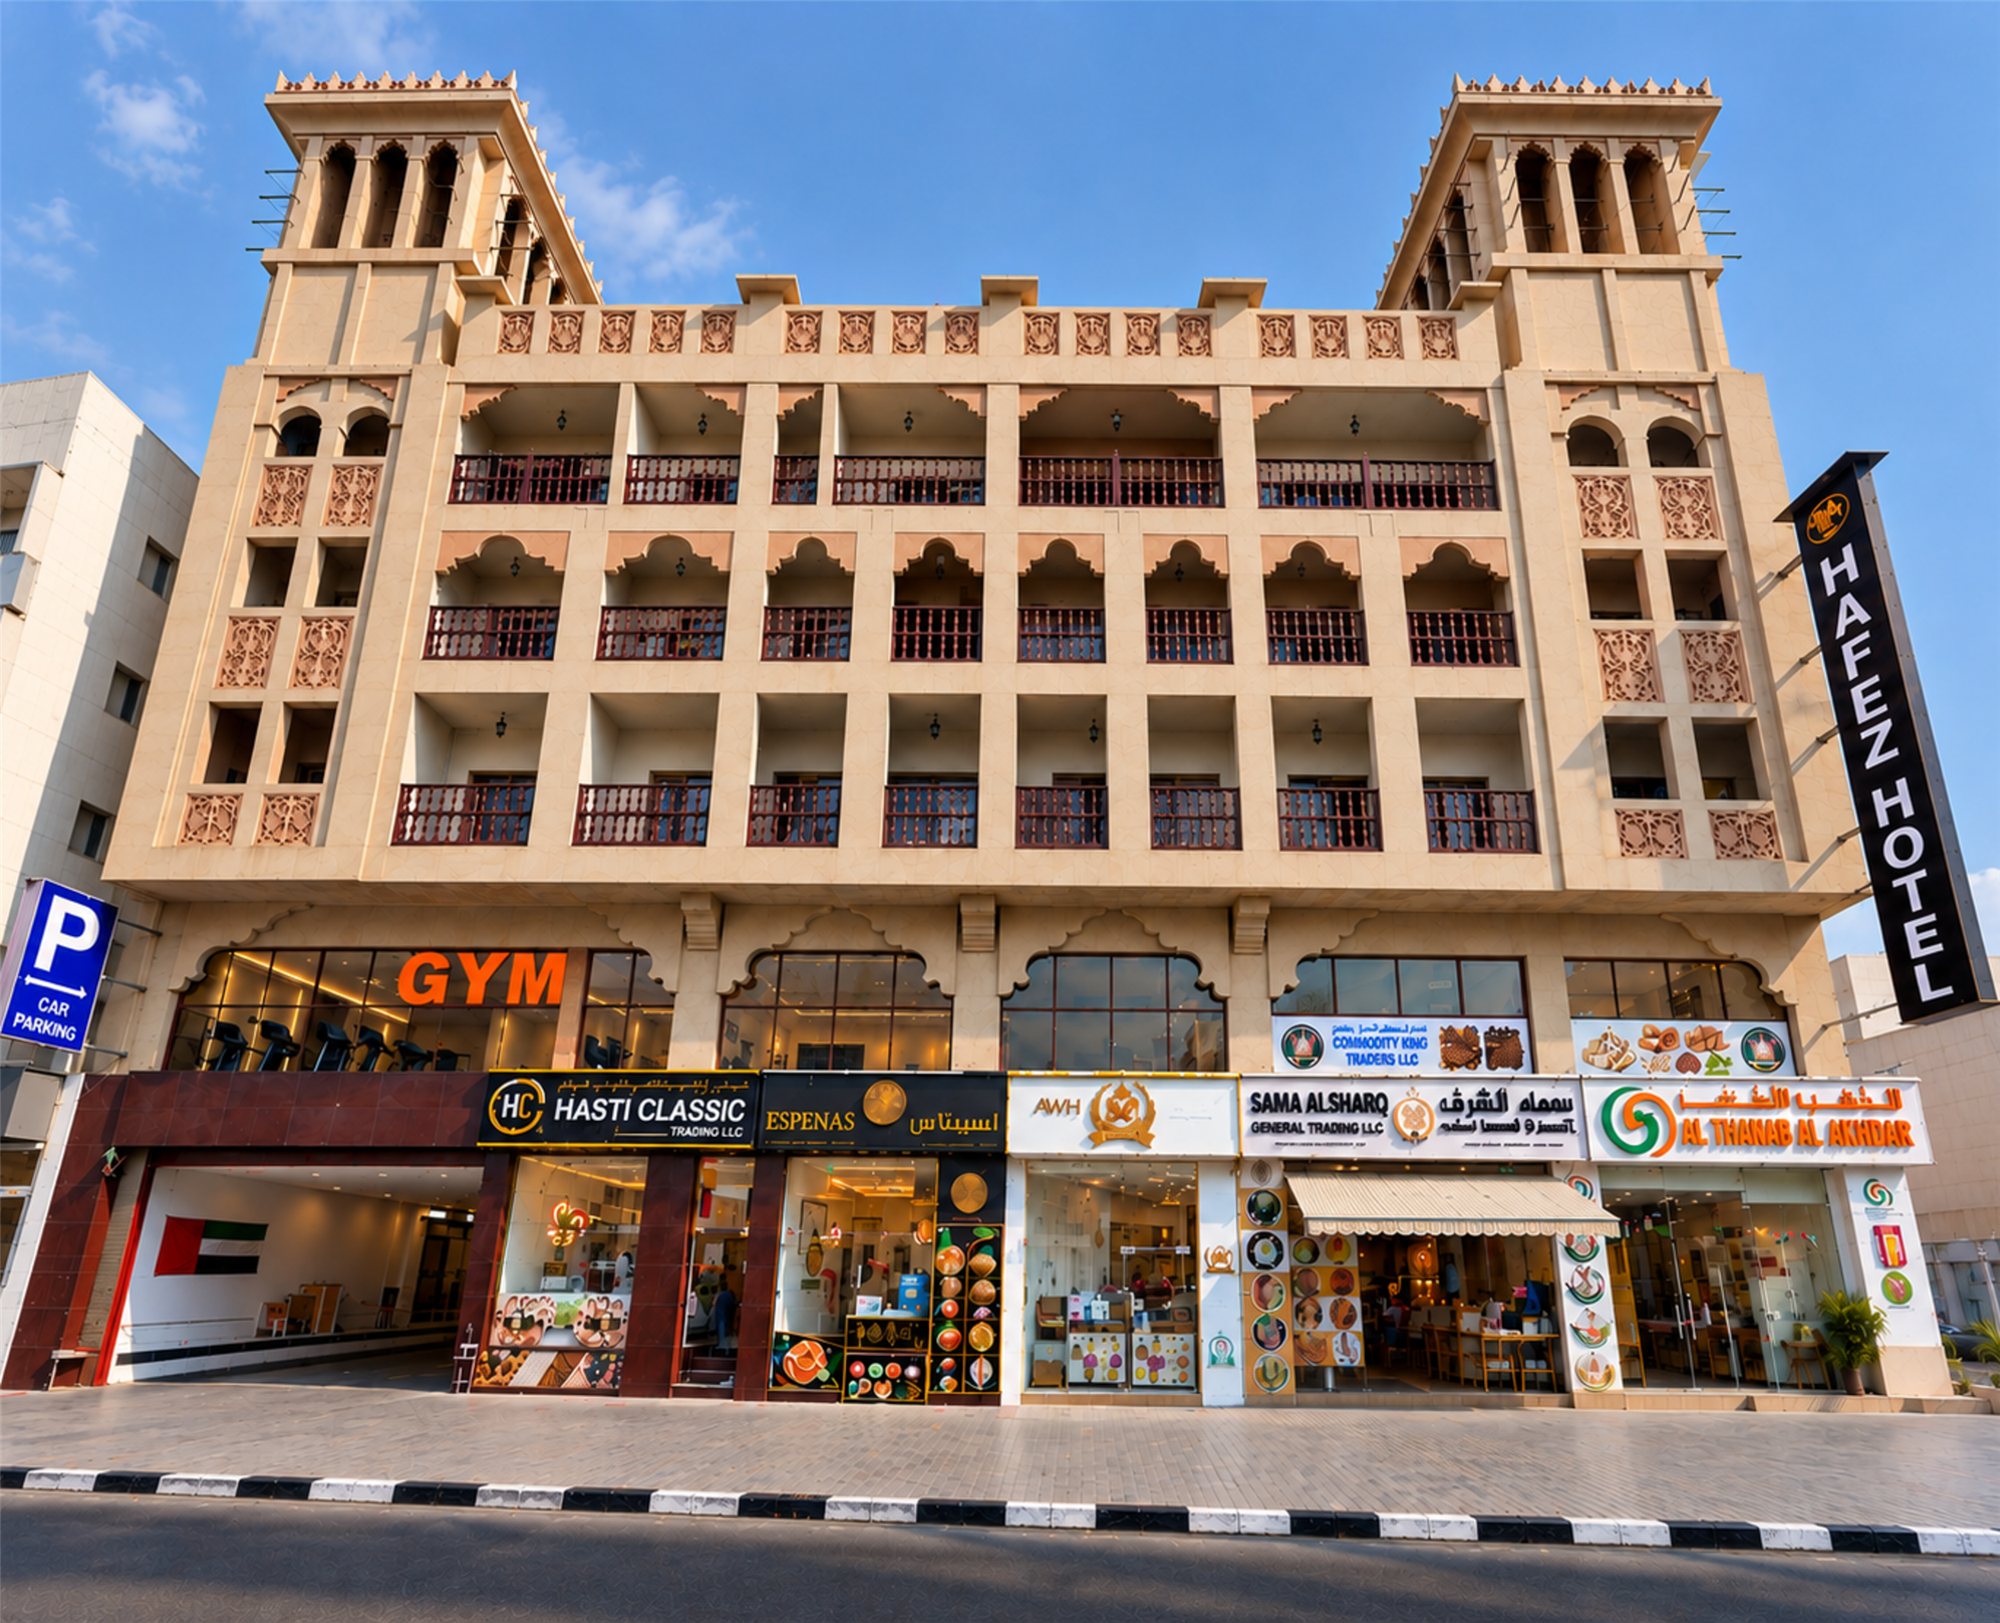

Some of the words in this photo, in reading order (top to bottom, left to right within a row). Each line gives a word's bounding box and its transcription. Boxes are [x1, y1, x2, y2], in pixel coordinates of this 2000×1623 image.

[1819, 542, 1899, 770] HAFEZ
[1871, 776, 1954, 1002] HOTEL
[33, 894, 100, 973] P
[398, 951, 567, 1006] GYM
[38, 997, 70, 1017] CAR
[12, 1012, 77, 1041] PARKING
[1401, 1036, 1428, 1050] KING
[1345, 1052, 1396, 1067] TRADERS
[1398, 1052, 1419, 1067] LLC
[501, 1093, 534, 1119] HC
[554, 1098, 633, 1122] HASTI
[637, 1098, 746, 1123] CLASSIC
[1034, 1097, 1081, 1115] AWH
[1250, 1092, 1302, 1114] SAMA
[1305, 1092, 1389, 1118] ALSHARQ
[721, 1126, 744, 1138] LLC
[766, 1111, 855, 1131] ESPENAS
[1250, 1121, 1305, 1135] GENERAL
[1307, 1122, 1359, 1135] TRADING
[1361, 1121, 1384, 1135] LLC
[1681, 1118, 1708, 1146] AL
[1710, 1118, 1793, 1146] THANAB
[1797, 1118, 1824, 1146] AL
[1828, 1119, 1915, 1147] AKHDAR
